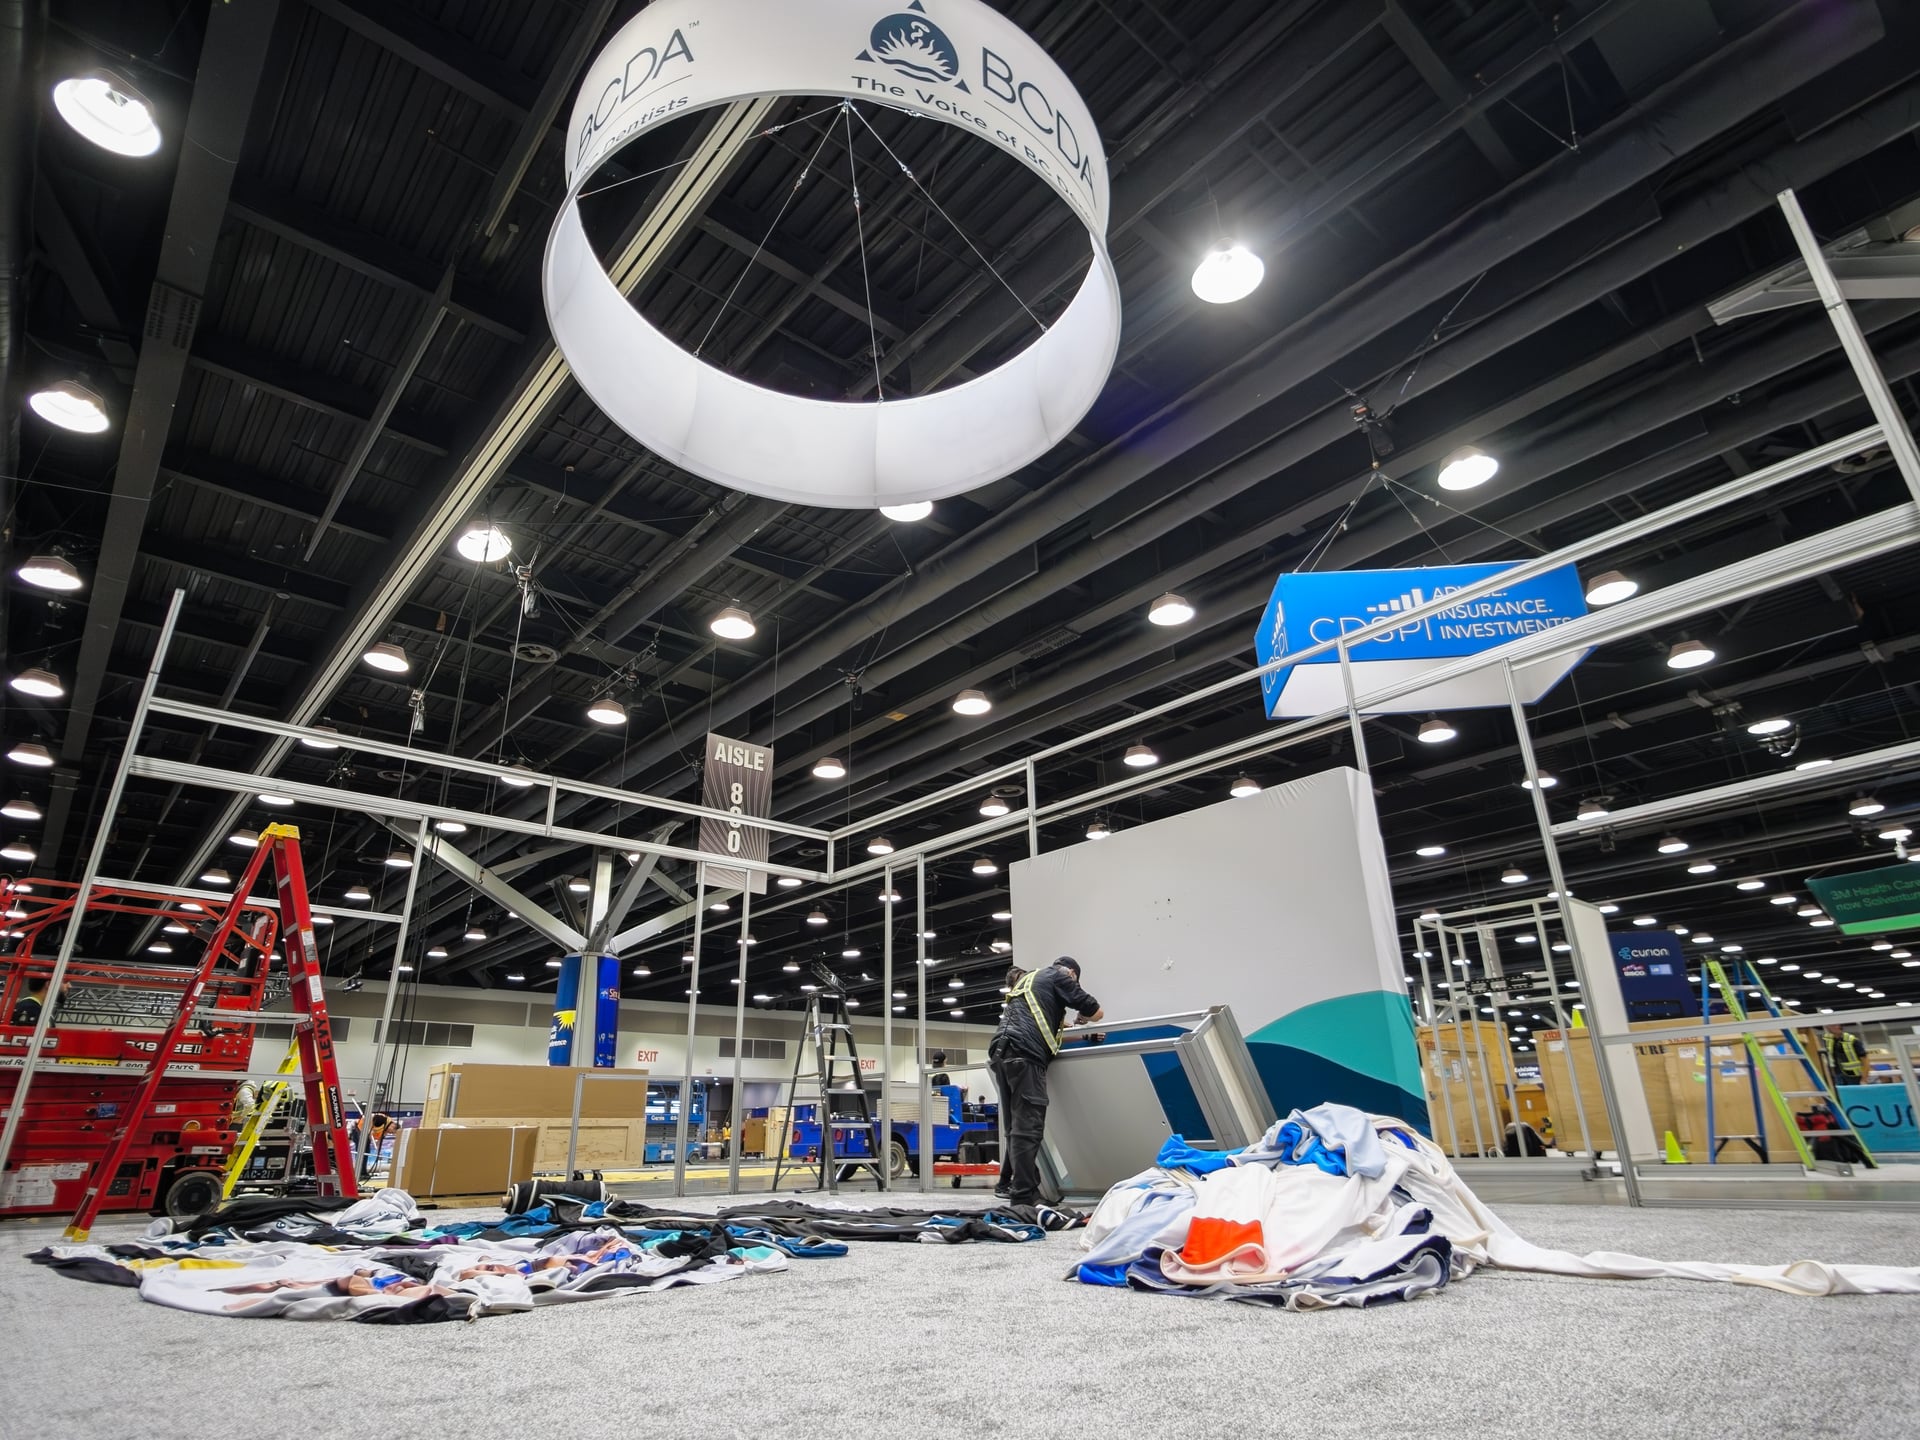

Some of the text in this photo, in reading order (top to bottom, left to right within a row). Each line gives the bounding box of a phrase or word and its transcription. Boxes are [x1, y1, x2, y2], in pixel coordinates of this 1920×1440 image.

[575, 28, 694, 170] BCDA
[851, 75, 1052, 177] The Voice of BC
[982, 46, 1096, 208] BCDA
[1437, 598, 1554, 620] INSURANCE.
[714, 742, 765, 772] AISLE
[637, 1050, 658, 1062] EXIT
[860, 1060, 876, 1070] EXIT
[331, 1092, 341, 1129] LOUISVILLE
